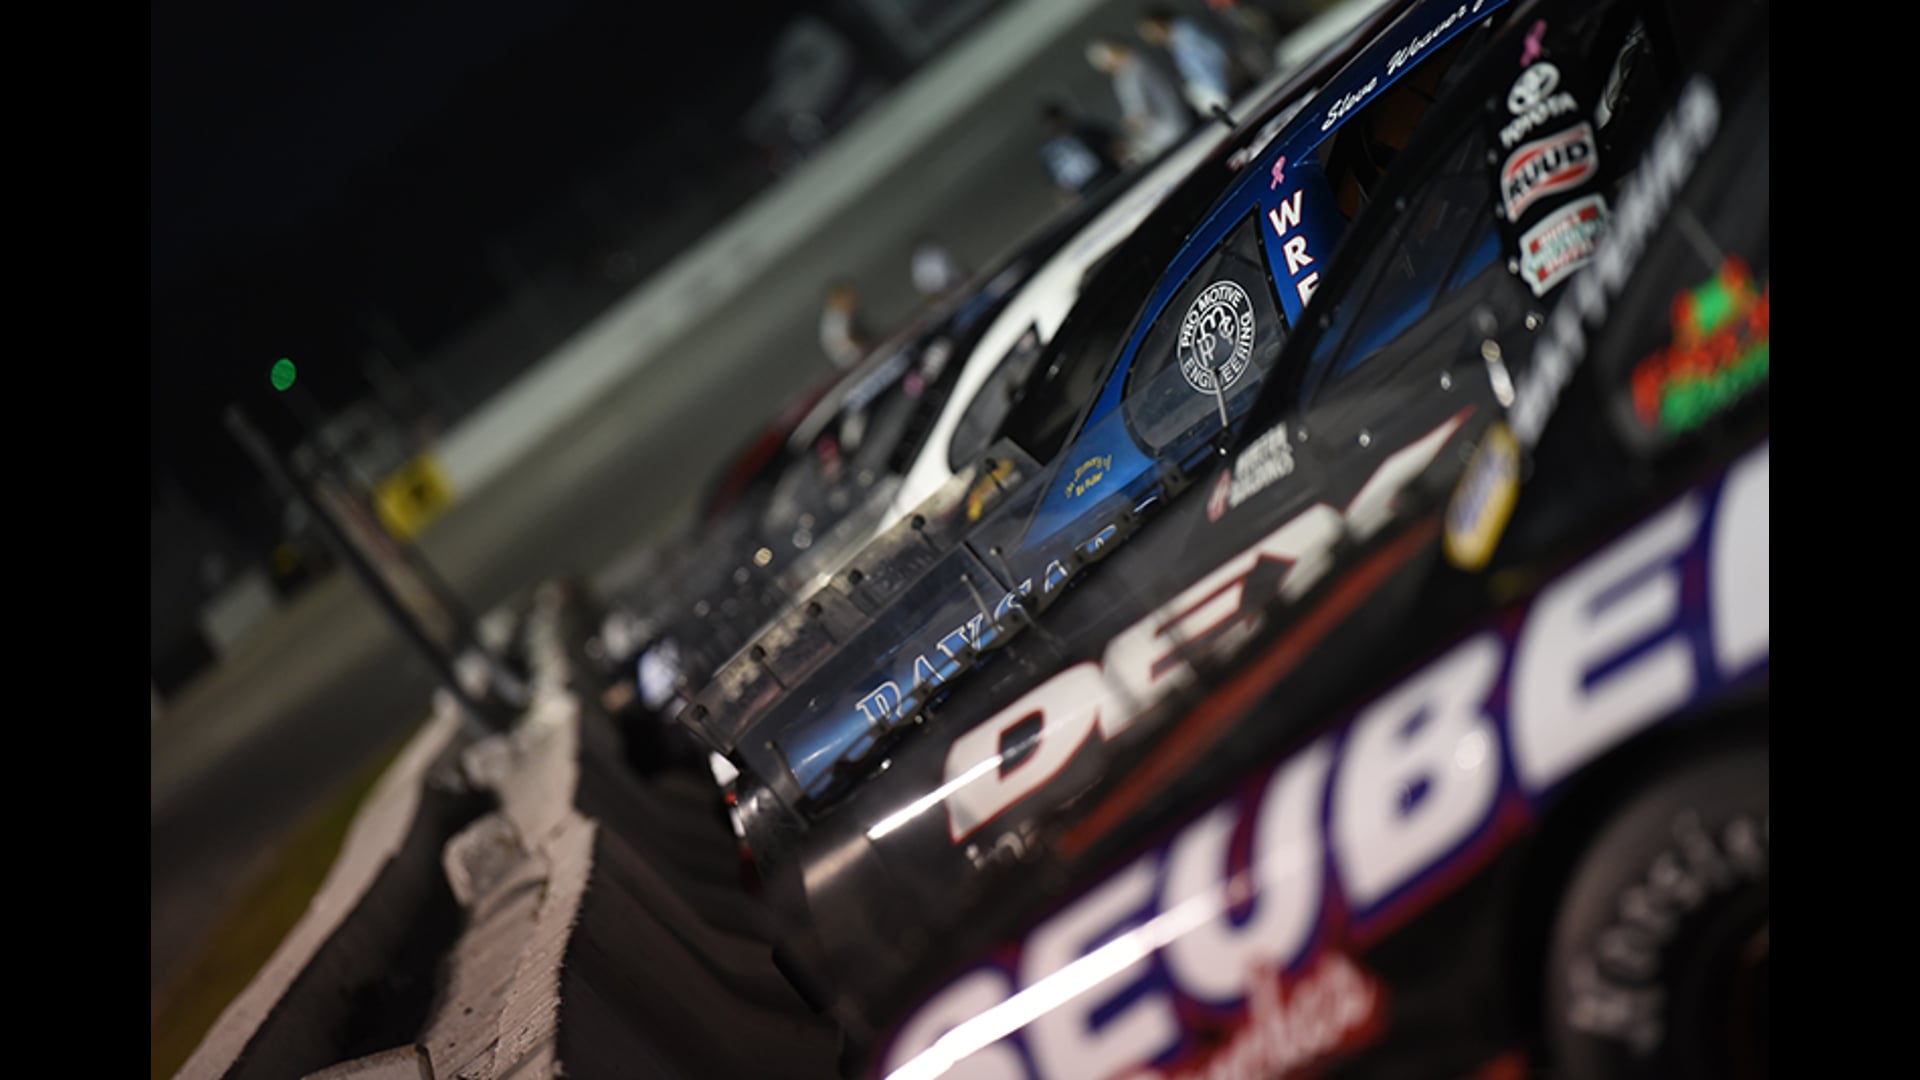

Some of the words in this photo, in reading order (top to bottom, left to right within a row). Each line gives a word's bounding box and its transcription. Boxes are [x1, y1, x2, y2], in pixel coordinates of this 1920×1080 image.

[1499, 91, 1579, 148] TOYOTA
[1507, 140, 1590, 201] RUUD
[1181, 309, 1200, 349] PRO
[1199, 285, 1246, 313] MOTIVE
